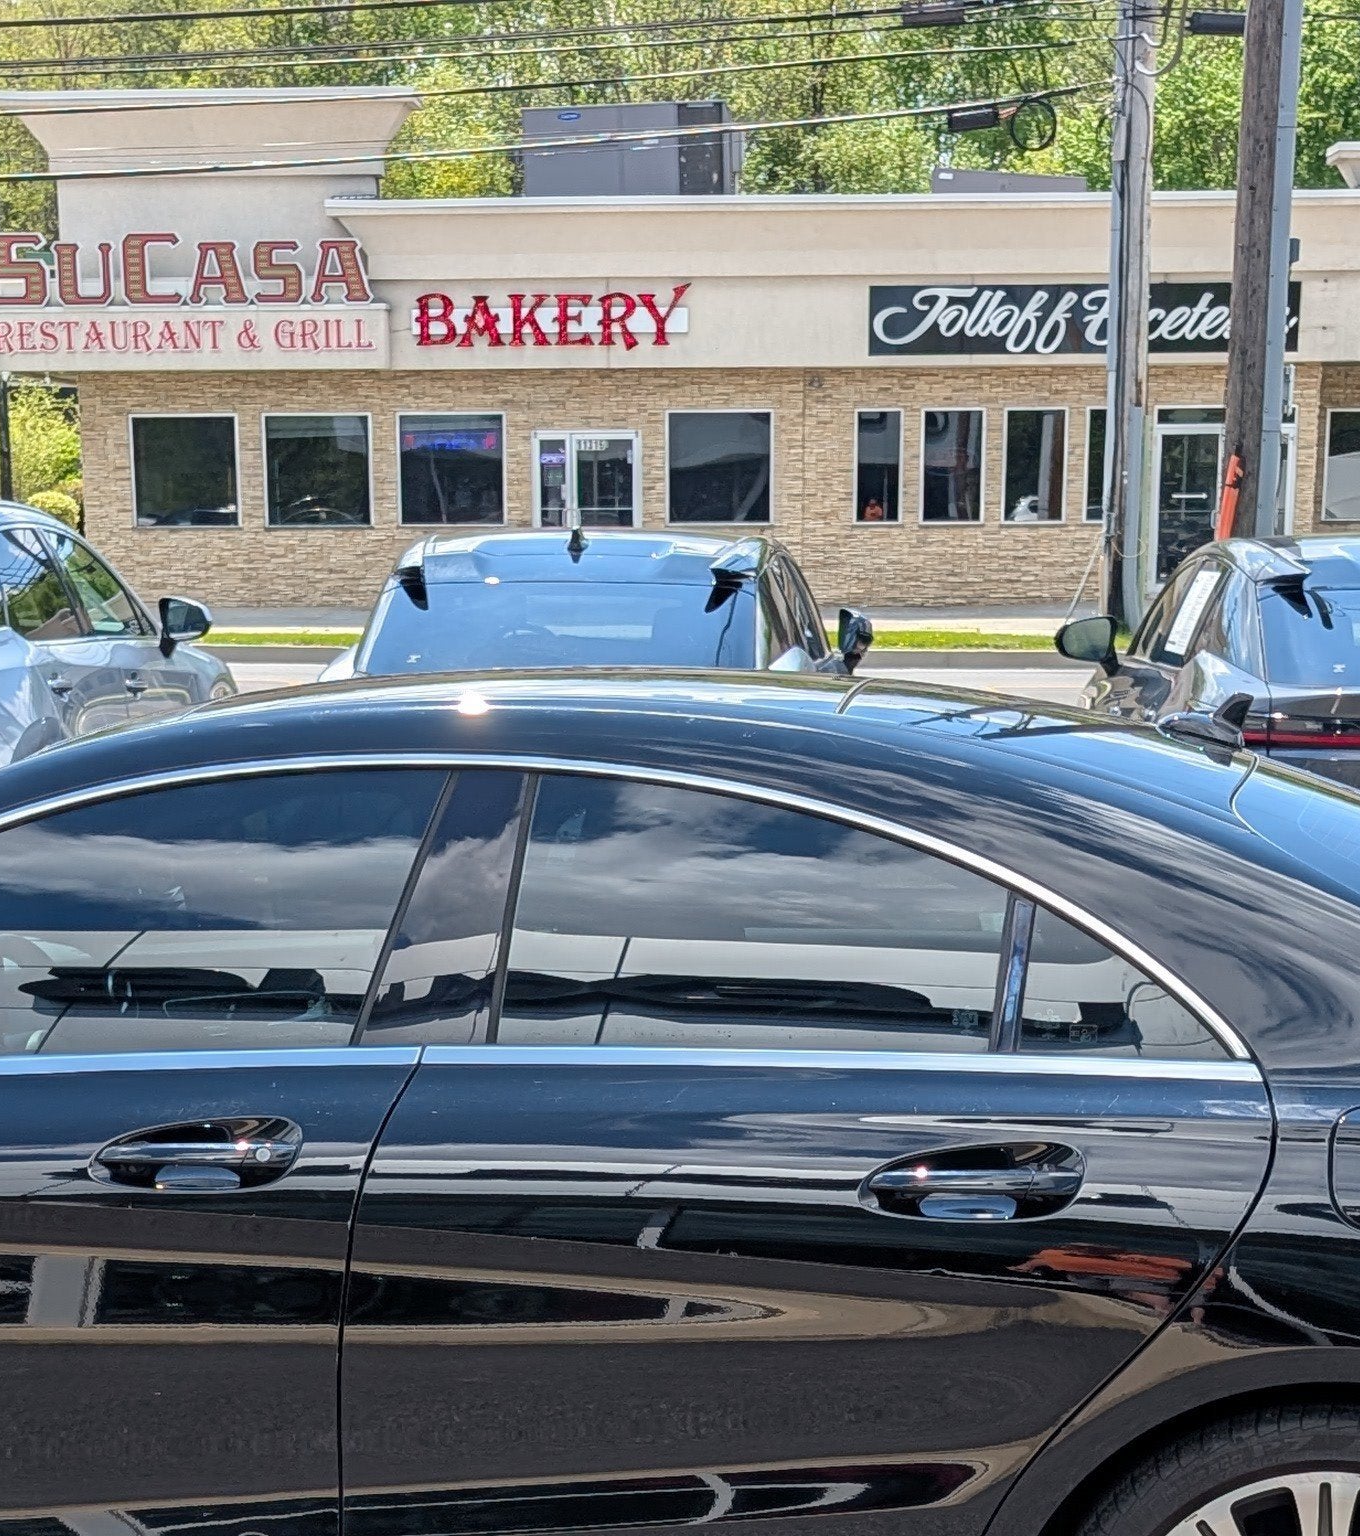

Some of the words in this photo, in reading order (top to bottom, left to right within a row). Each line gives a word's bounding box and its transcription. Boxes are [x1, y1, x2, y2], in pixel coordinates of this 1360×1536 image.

[237, 321, 261, 350] &
[274, 319, 376, 351] GRILL
[415, 282, 692, 350] BAKERY
